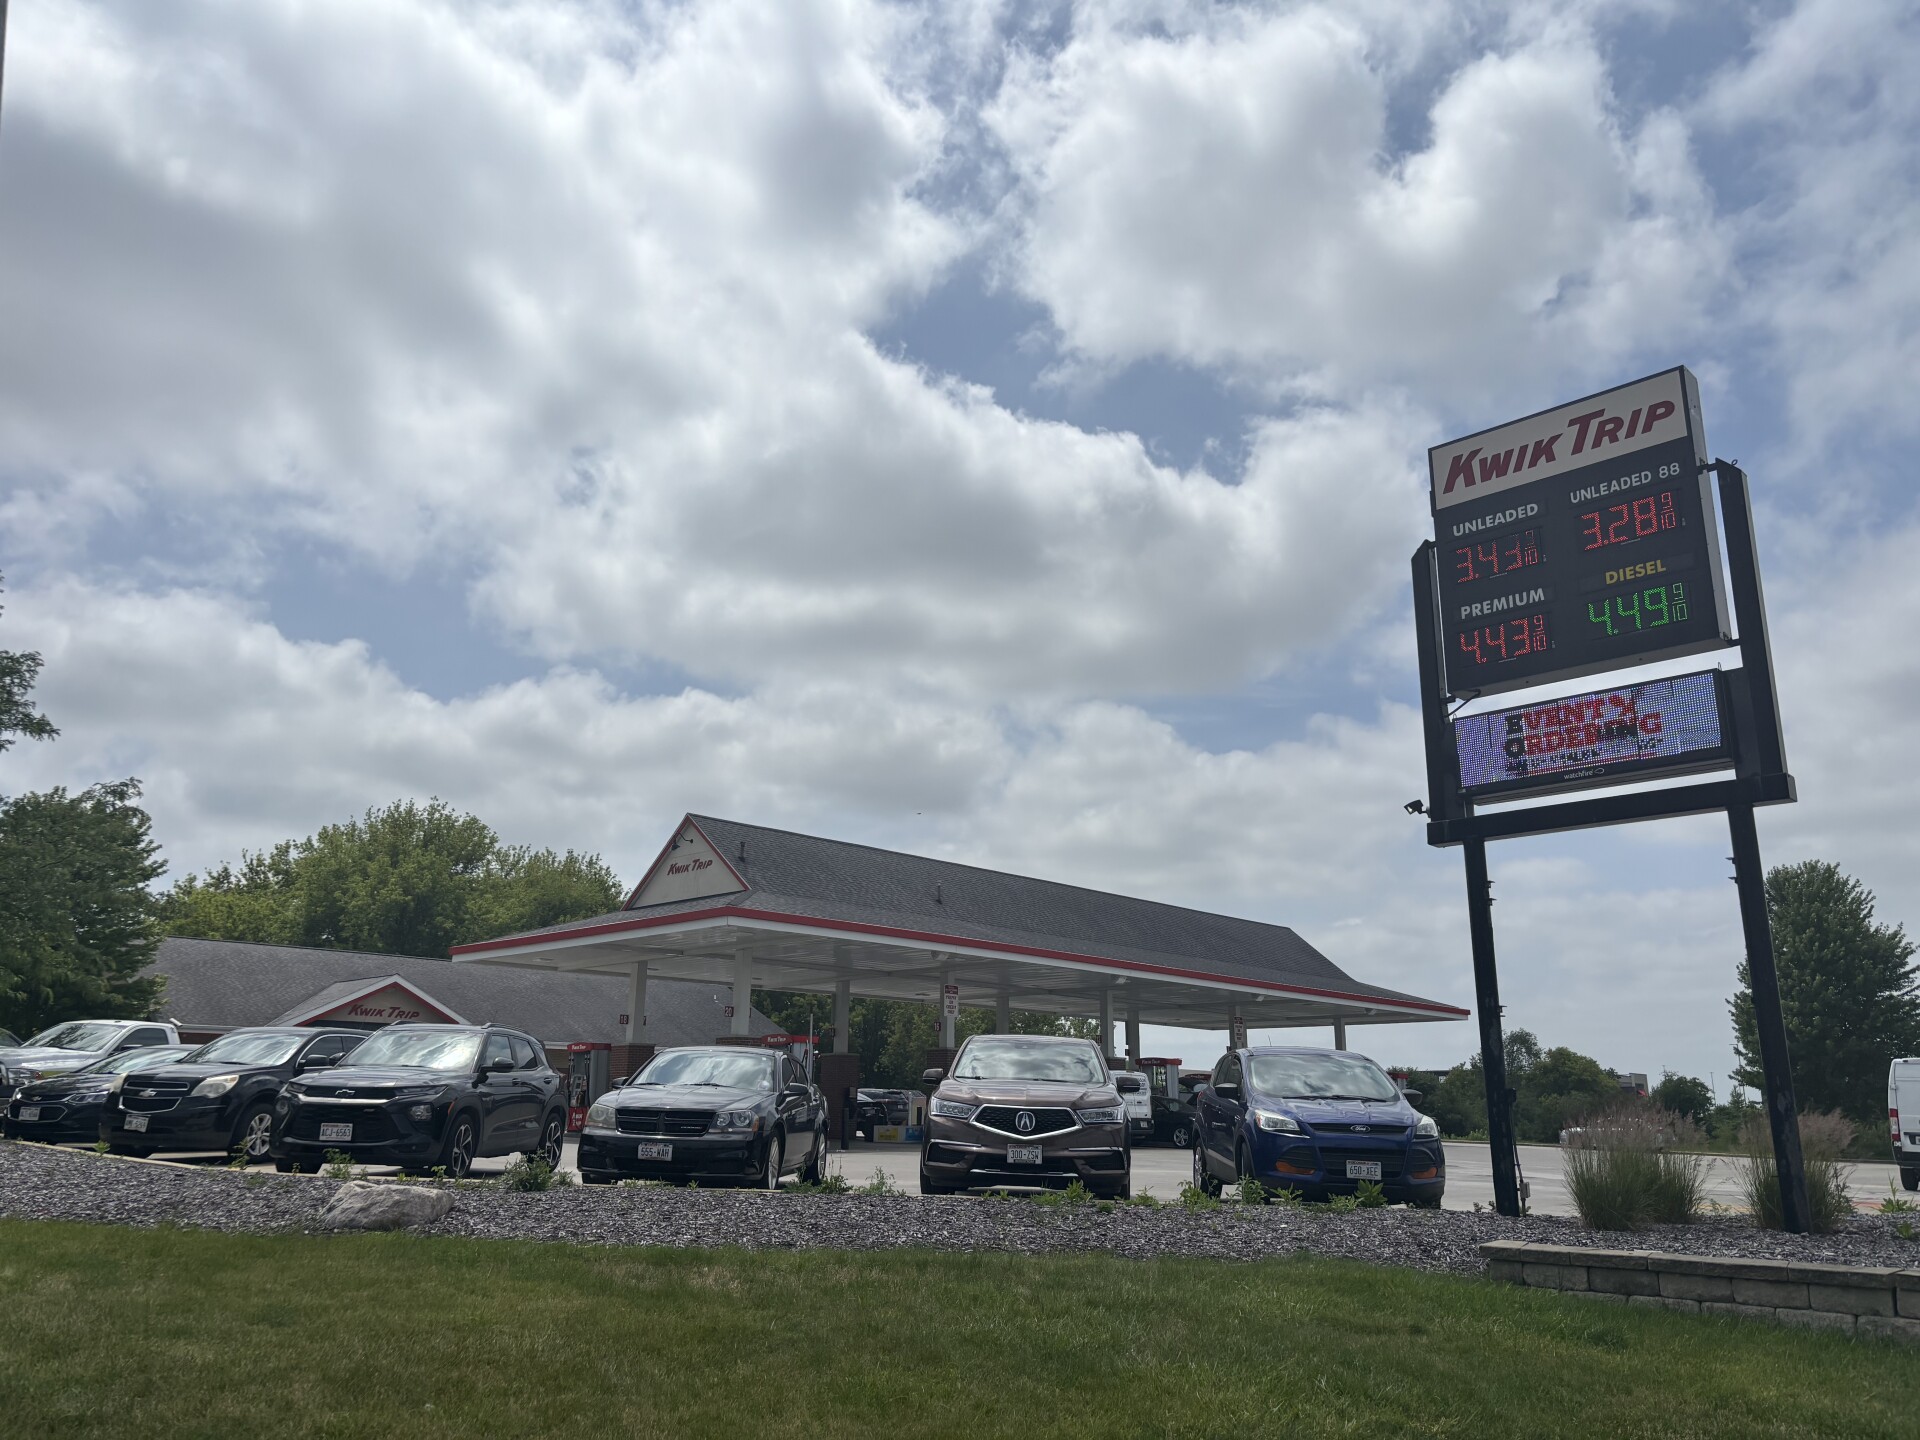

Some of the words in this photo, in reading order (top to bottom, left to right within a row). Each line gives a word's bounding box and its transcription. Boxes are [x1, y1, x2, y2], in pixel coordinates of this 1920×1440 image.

[1569, 471, 1652, 503] UNLEADED
[1658, 462, 1680, 479] 88
[1452, 503, 1538, 537] UNLEADED
[1581, 496, 1659, 550] 3.28
[1605, 559, 1667, 585] DIESEL
[1460, 587, 1545, 620] PREMIUM
[1588, 586, 1669, 636] 4.49
[1460, 617, 1531, 664] 4.43
[1563, 769, 1594, 781] watchfire
